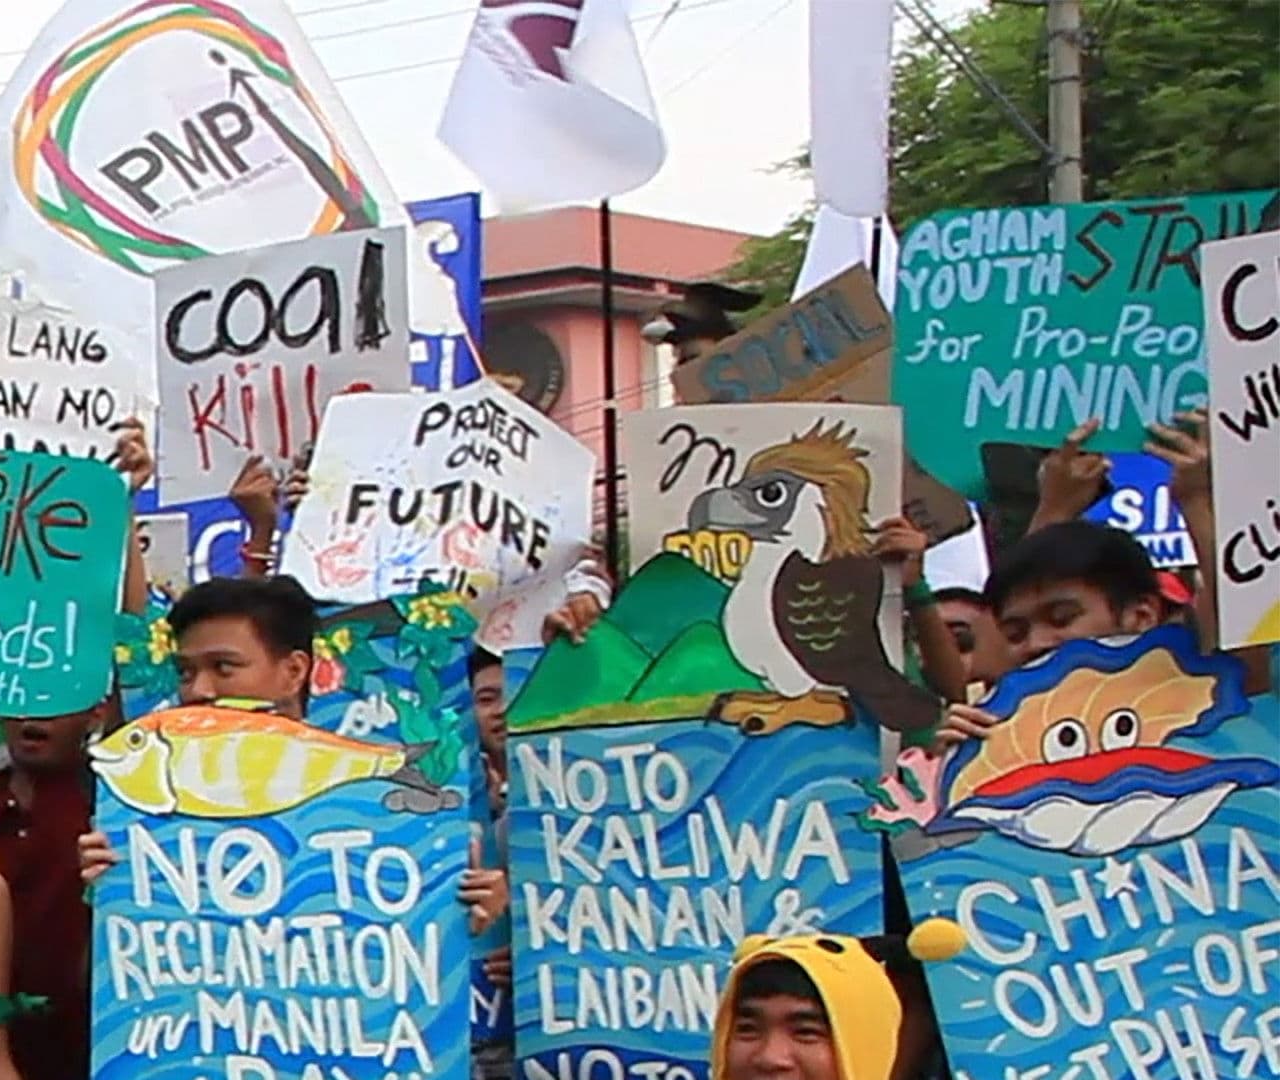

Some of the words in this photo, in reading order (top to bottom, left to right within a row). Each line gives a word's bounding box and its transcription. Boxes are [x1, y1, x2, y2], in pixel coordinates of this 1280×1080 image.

[100, 100, 254, 212] PMP
[903, 208, 1066, 265] AGHAM
[899, 253, 1062, 311] YOUTH
[8, 316, 108, 364] LANG
[906, 318, 982, 362] for
[414, 399, 540, 461] PROTECT
[964, 364, 1208, 431] MINING
[446, 447, 503, 475] OUR
[346, 481, 550, 570] FUTURE
[308, 829, 423, 915] TO
[542, 795, 850, 884] KALIWA
[523, 882, 746, 953] KANAN
[105, 914, 440, 1006] RECLAMATION
[994, 950, 1148, 1038] OUT
[197, 991, 433, 1073] MANILA
[540, 962, 717, 1034] LAIBAN
